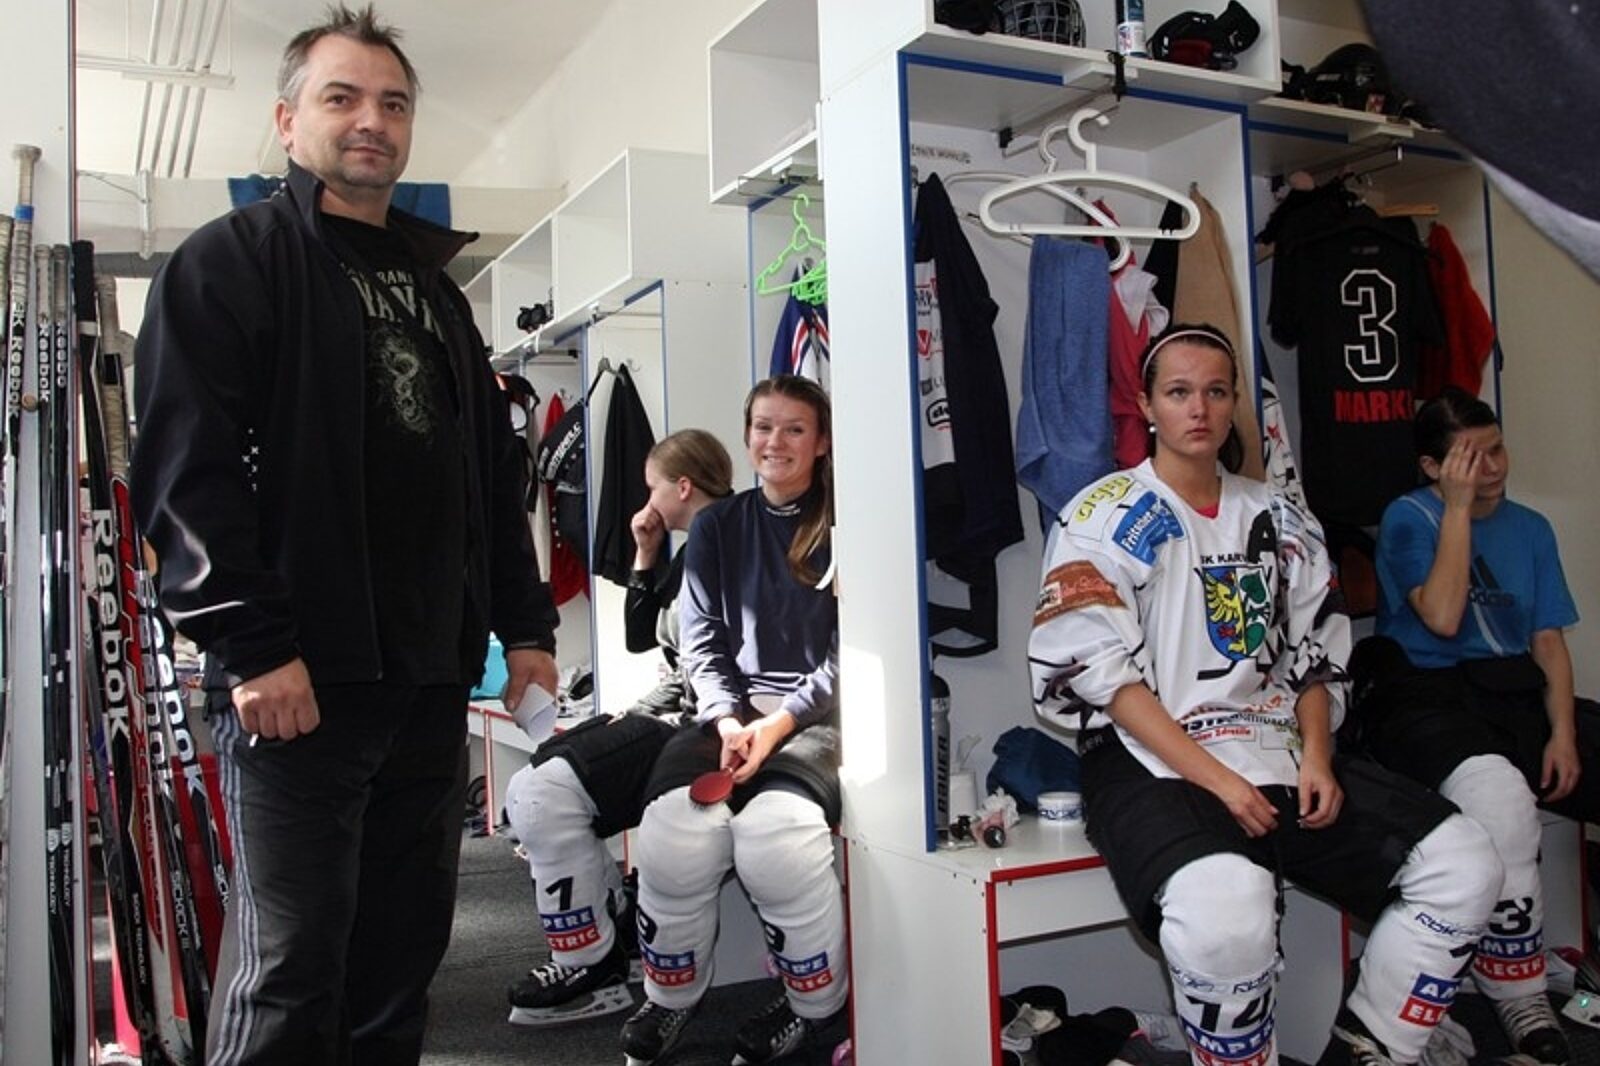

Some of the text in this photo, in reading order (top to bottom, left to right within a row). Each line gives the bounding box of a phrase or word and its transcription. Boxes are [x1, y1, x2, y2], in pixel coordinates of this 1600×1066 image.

[1341, 269, 1399, 382] 3
[8, 336, 24, 419] Reebok
[38, 323, 51, 403] Reebok
[1335, 388, 1413, 422] MARK
[93, 509, 132, 744] Reebok
[545, 876, 574, 911] 1
[1488, 896, 1534, 936] 3
[1185, 987, 1272, 1033] 14
